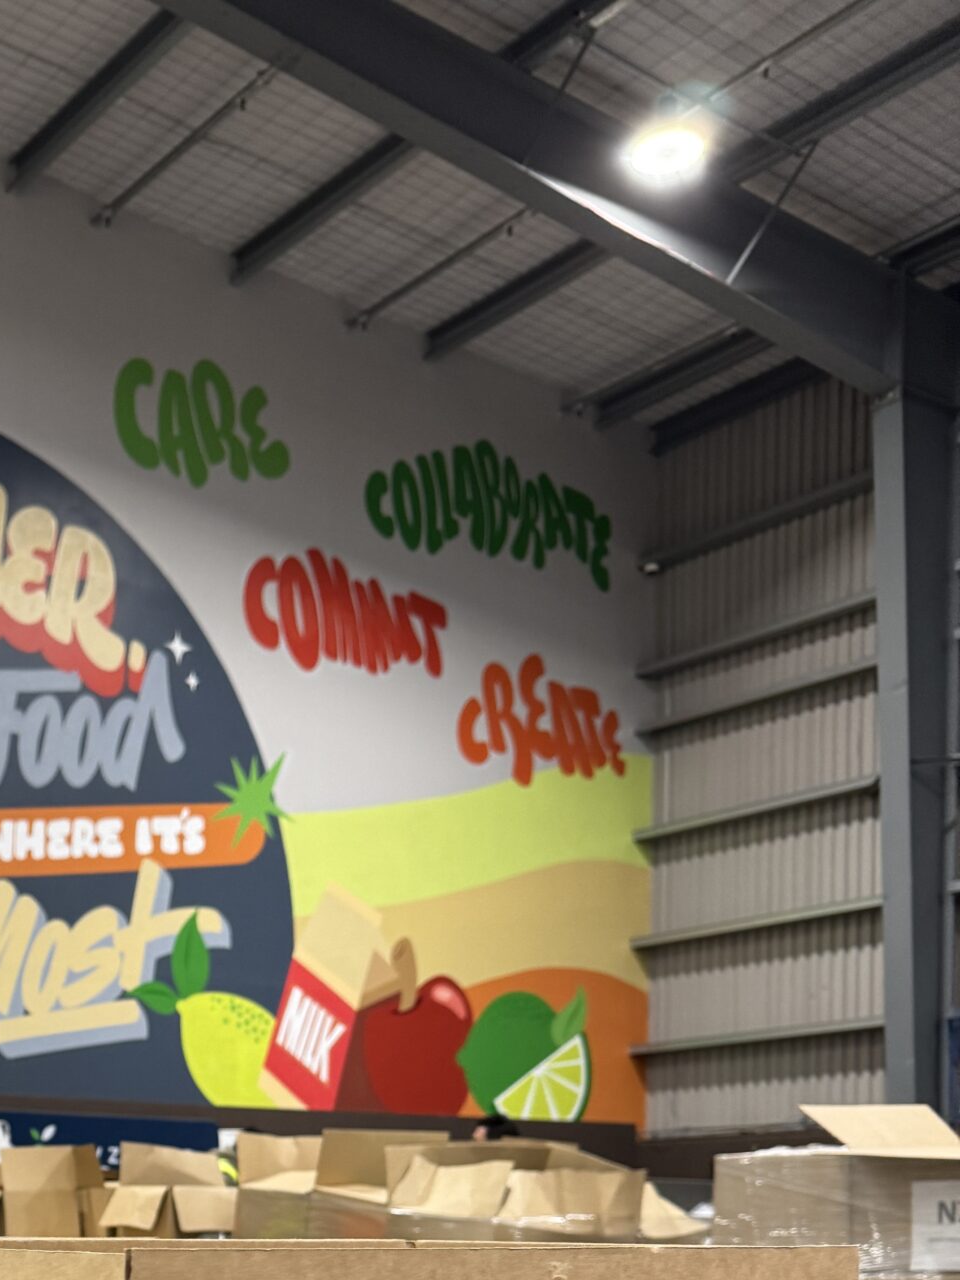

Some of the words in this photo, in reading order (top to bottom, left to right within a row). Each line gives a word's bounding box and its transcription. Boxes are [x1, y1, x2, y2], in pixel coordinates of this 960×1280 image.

[113, 356, 290, 489] CARE
[365, 439, 612, 593] COLLABORATE
[243, 547, 448, 679] COMMIT
[457, 653, 627, 788] CREATE
[135, 807, 206, 857] IT'S
[275, 985, 347, 1084] MILK
